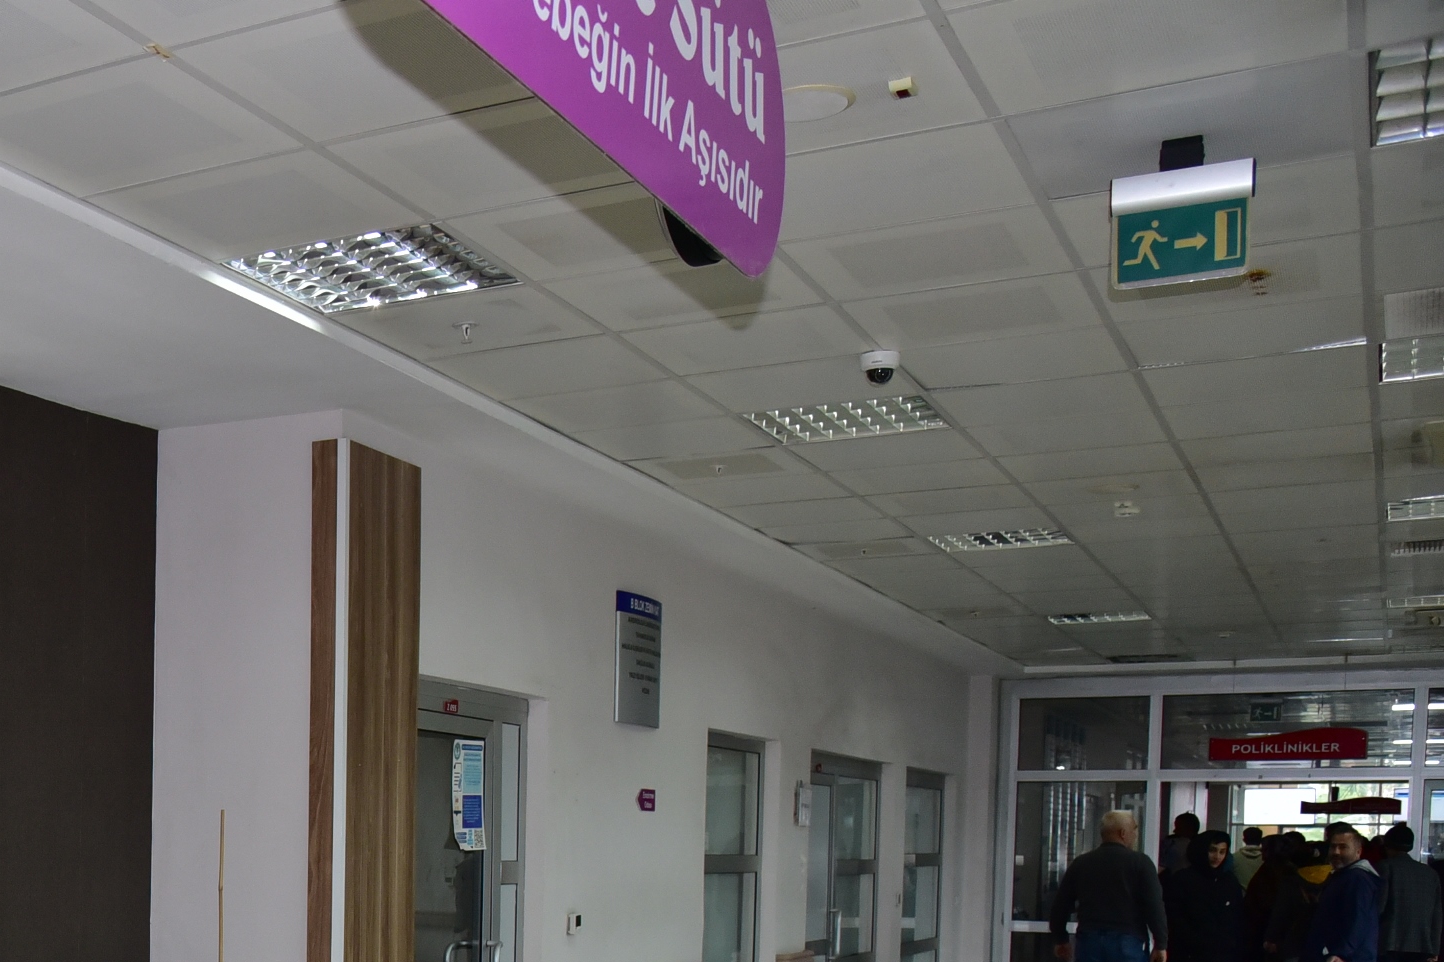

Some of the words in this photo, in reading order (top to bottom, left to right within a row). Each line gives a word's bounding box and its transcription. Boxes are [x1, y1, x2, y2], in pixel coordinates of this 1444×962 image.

[643, 41, 675, 142] İlk
[678, 99, 763, 225] Aşısıdır
[670, 0, 765, 144] Sütü
[1231, 740, 1340, 755] POLİKLİNİKLER
